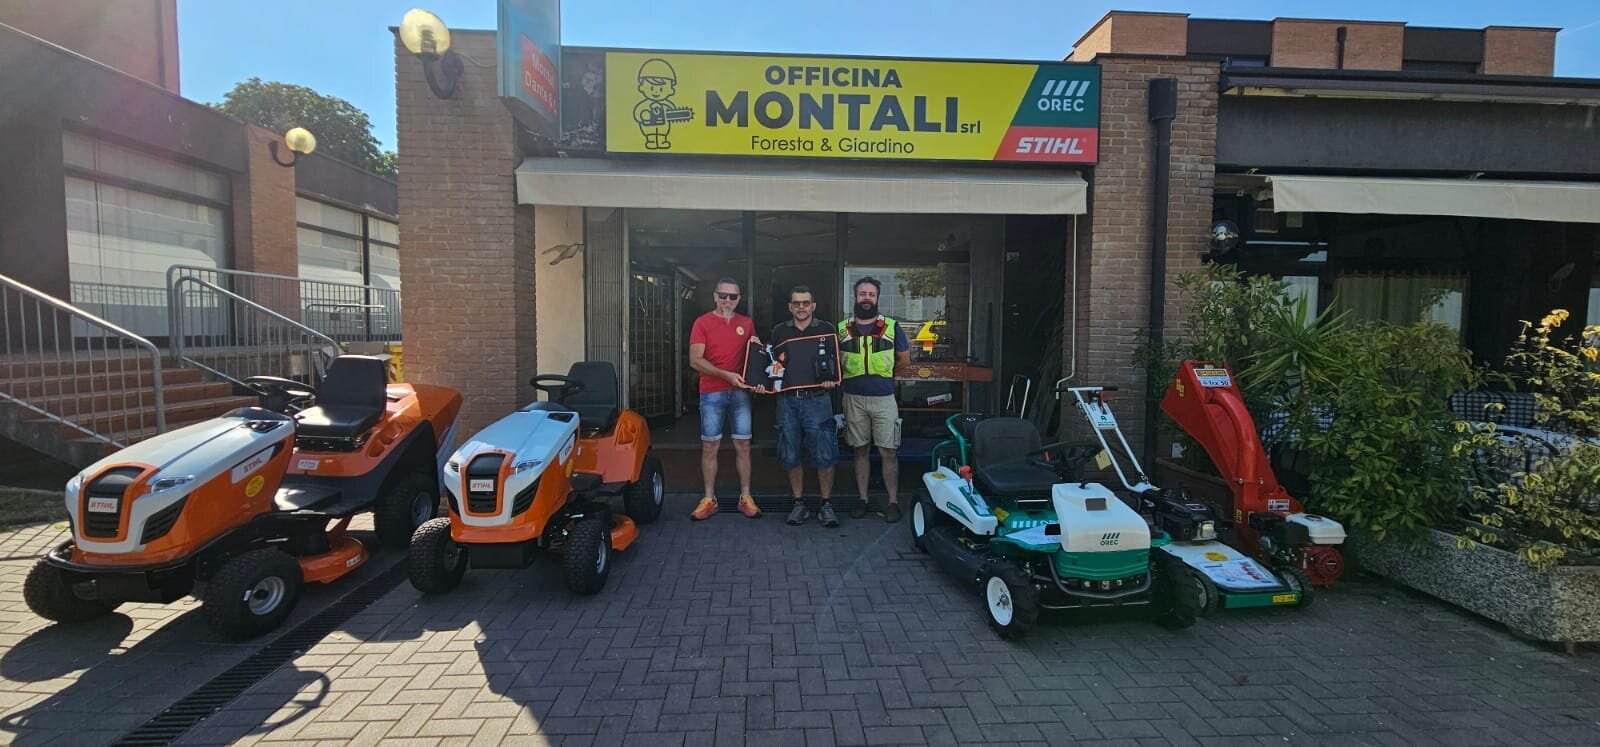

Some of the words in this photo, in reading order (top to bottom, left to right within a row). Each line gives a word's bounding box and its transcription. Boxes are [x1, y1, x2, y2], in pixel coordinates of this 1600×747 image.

[765, 65, 903, 89] OFFICINA
[705, 90, 958, 133] MONTALI
[960, 120, 981, 134] srl
[1037, 98, 1085, 112] OREC
[751, 135, 814, 152] Foresta
[820, 137, 833, 152] &
[838, 137, 915, 154] Giardino
[1015, 137, 1084, 154] STIHL
